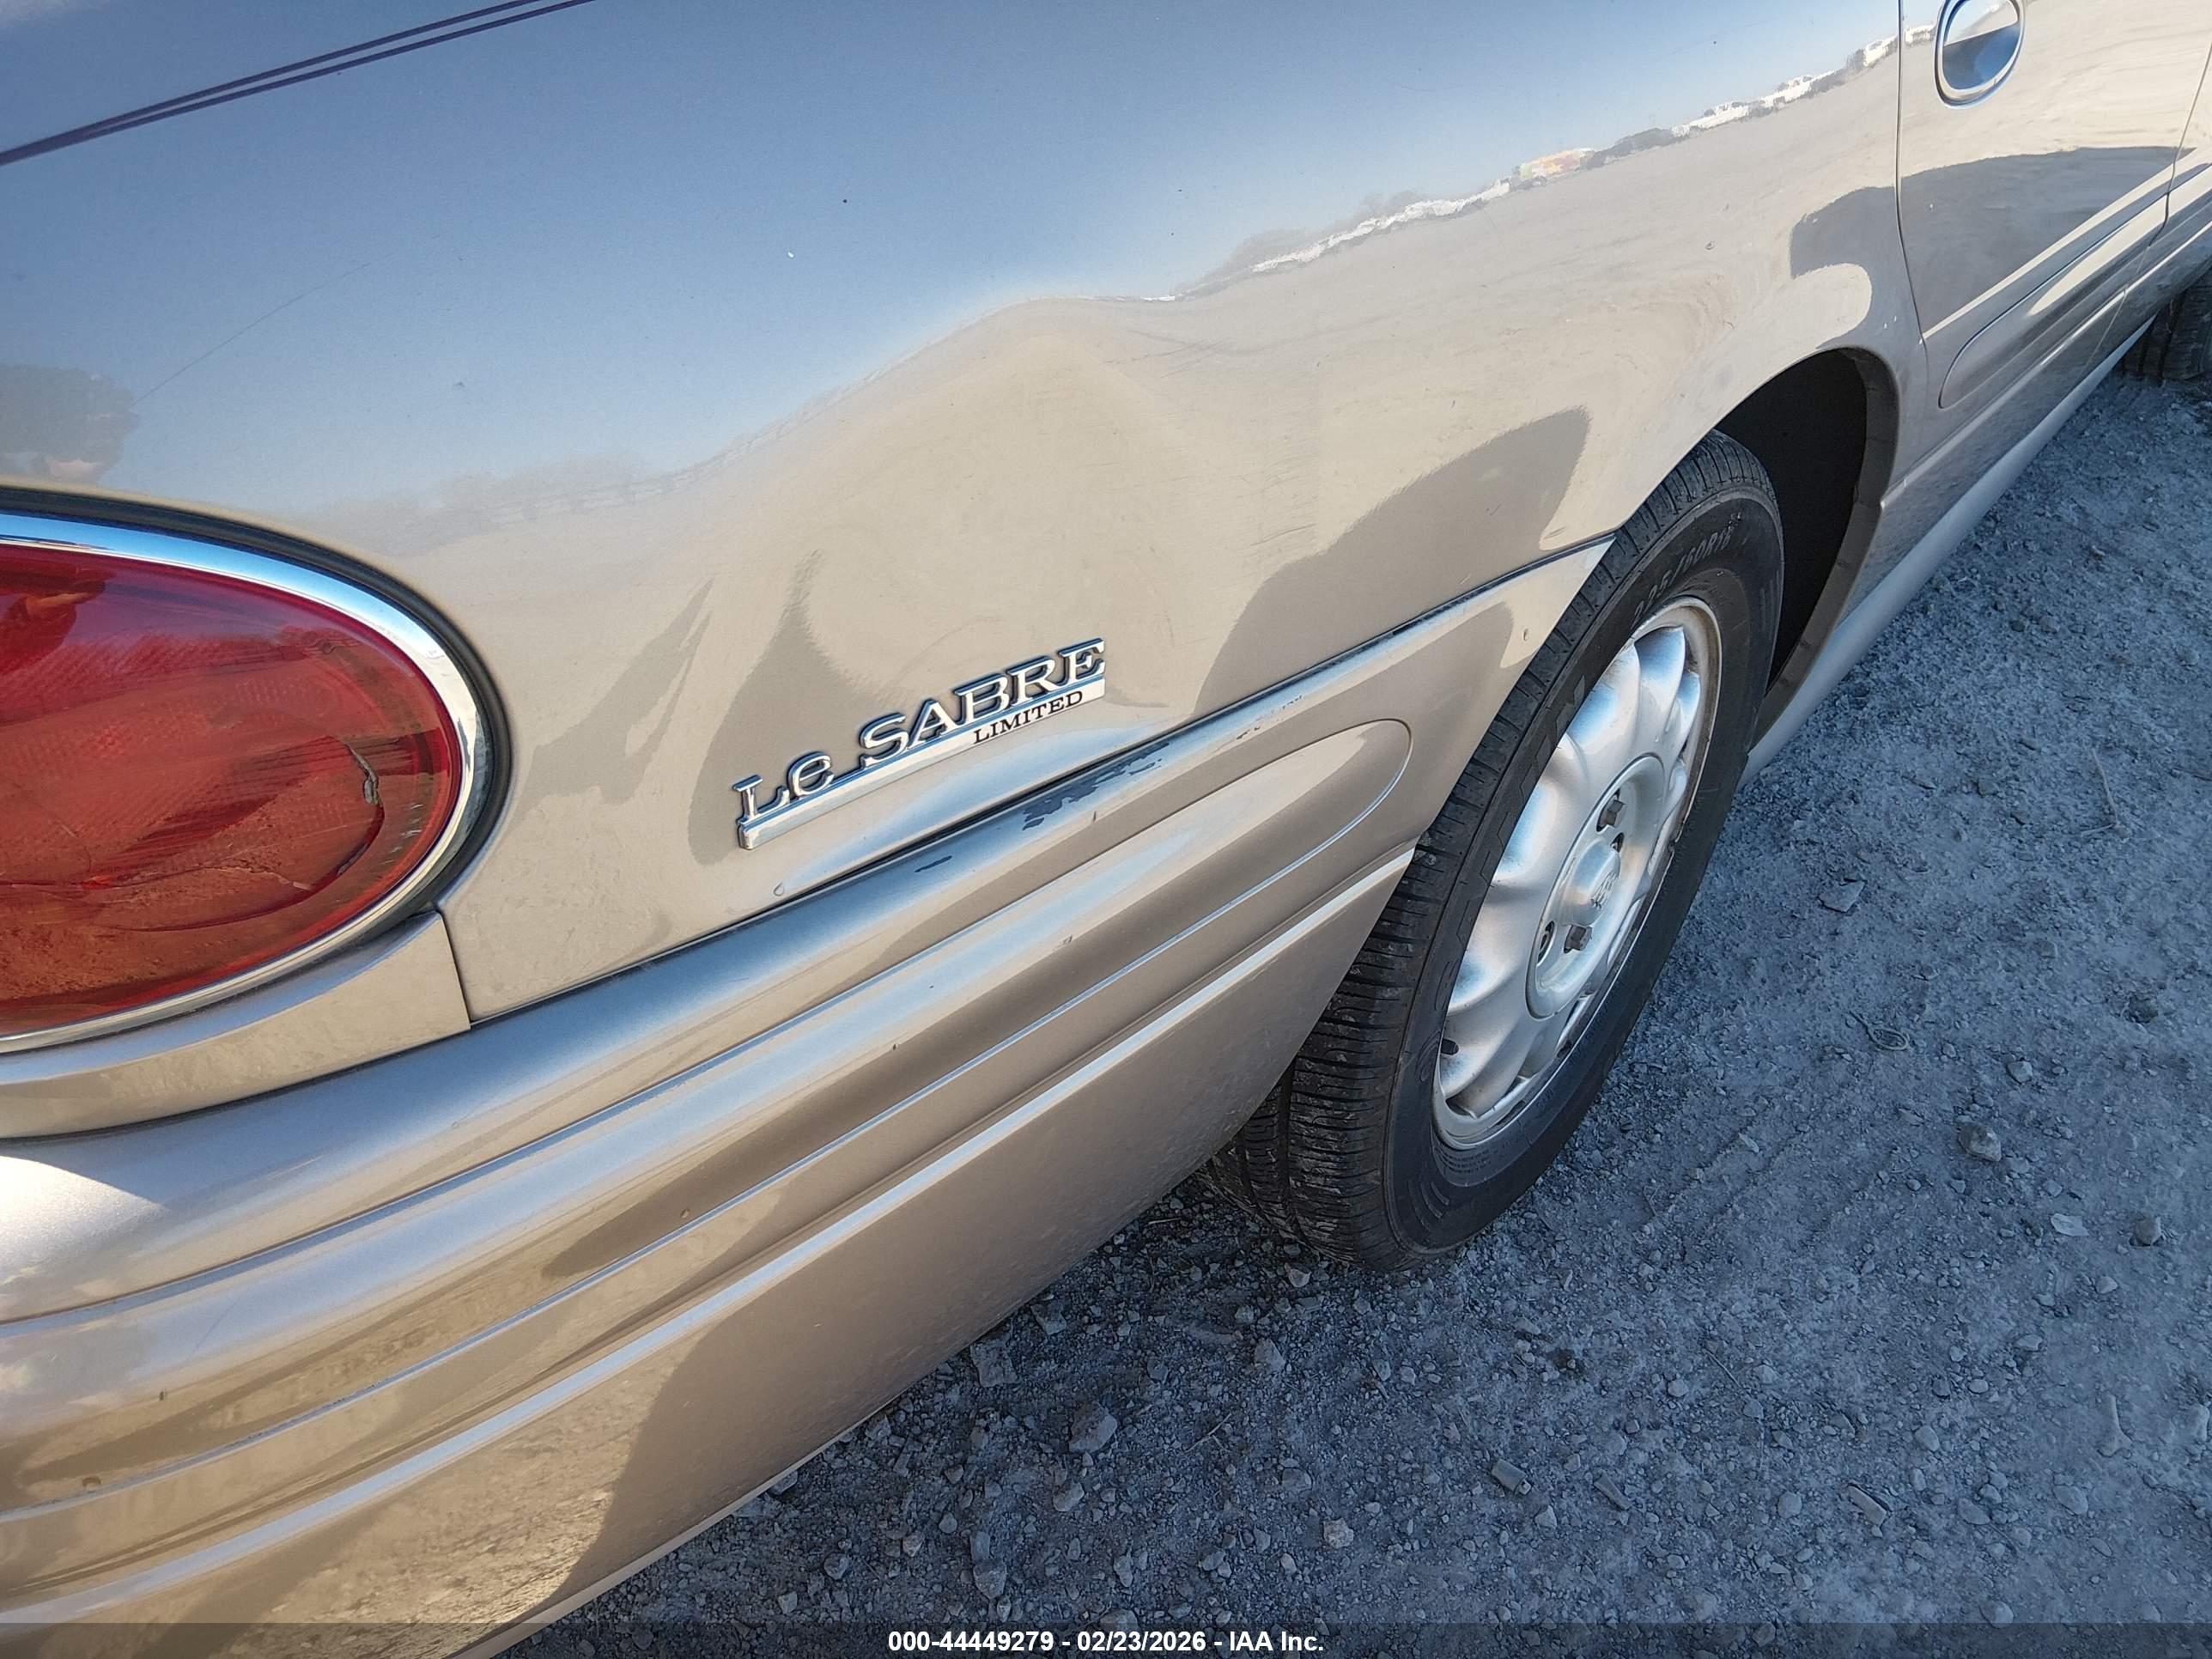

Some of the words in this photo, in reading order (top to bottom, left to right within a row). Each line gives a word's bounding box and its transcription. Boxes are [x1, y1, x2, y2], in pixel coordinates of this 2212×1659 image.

[733, 750, 835, 826] Le
[860, 638, 1106, 768] SABRE
[973, 690, 1084, 745] LIMITED
